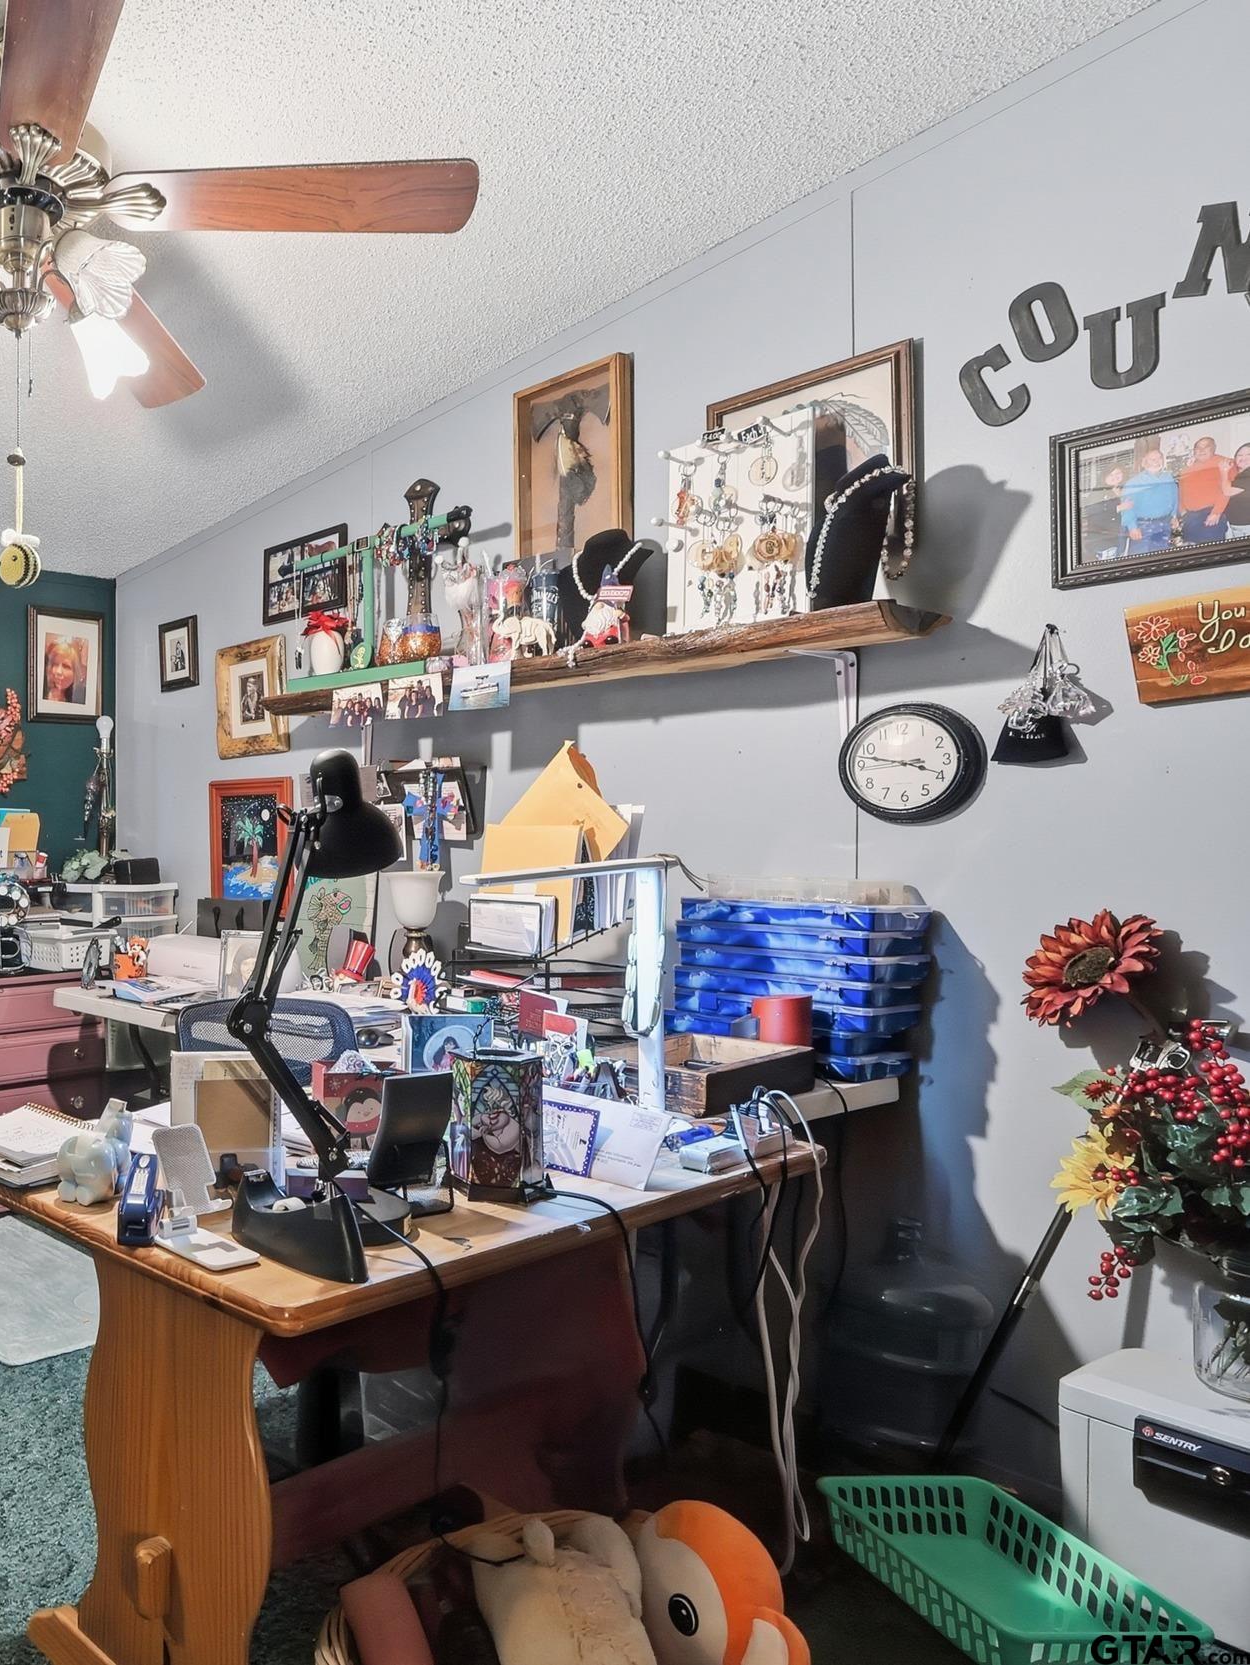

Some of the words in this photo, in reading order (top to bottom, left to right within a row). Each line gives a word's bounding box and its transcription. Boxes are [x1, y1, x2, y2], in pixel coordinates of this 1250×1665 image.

[879, 729, 888, 740] 11
[896, 723, 909, 735] 12
[921, 725, 925, 737] 1
[935, 736, 945, 749] 2
[862, 743, 876, 755] 10
[857, 759, 866, 771] 9
[942, 753, 952, 765] 3
[935, 770, 945, 782] 4
[865, 778, 875, 790] 8
[921, 784, 930, 796] 5
[881, 787, 891, 800] 7
[900, 790, 910, 803] 6
[1153, 1432, 1202, 1451] SENTRY
